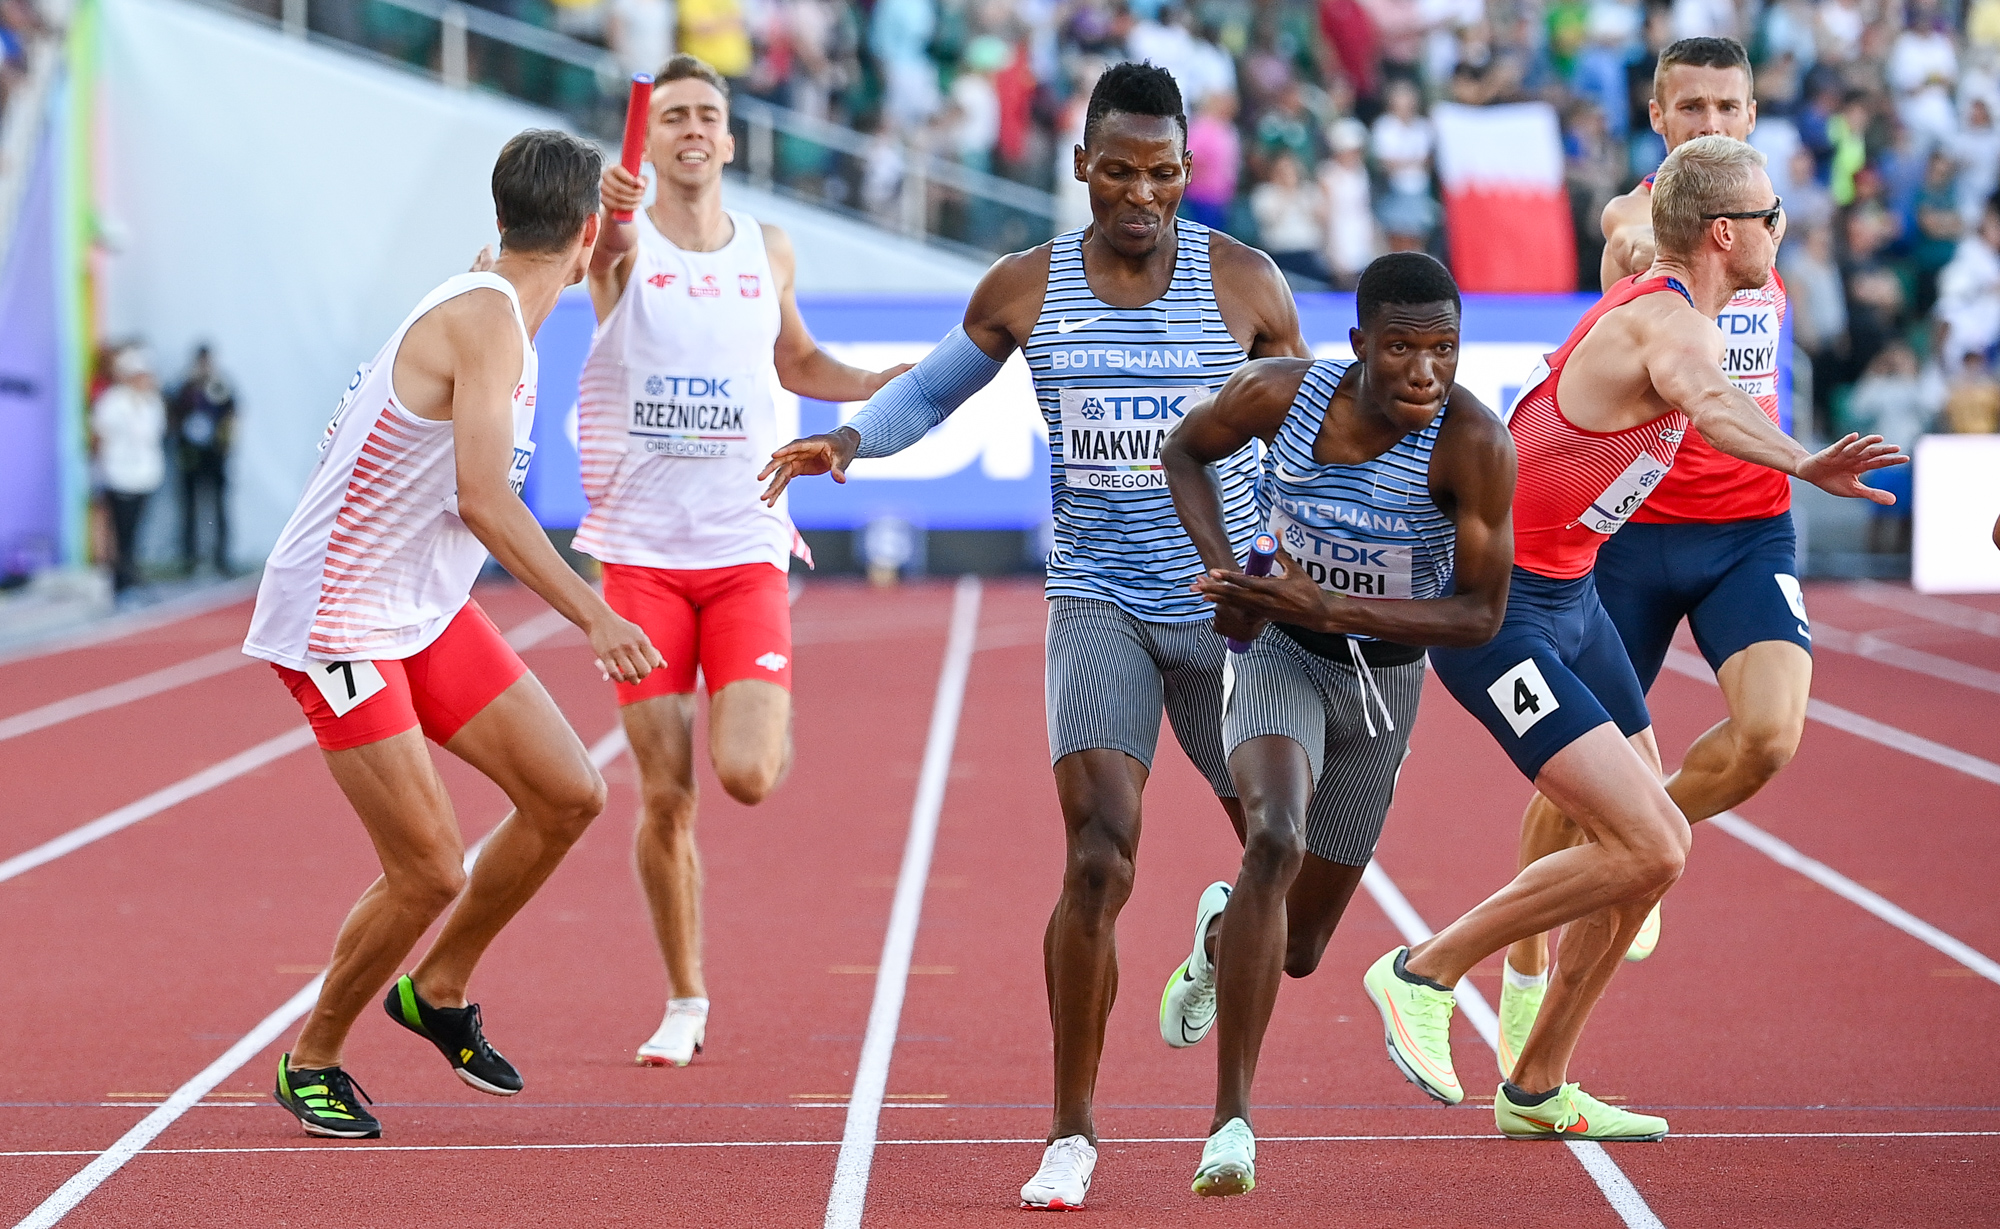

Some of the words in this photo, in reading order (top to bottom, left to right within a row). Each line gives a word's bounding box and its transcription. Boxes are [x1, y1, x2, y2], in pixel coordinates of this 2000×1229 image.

[1731, 288, 1775, 302] PUBLIC
[1052, 350, 1200, 370] BOTSWANA
[665, 376, 731, 398] TDK
[633, 400, 745, 431] RZEŹNICZAK
[1104, 395, 1188, 420] TDK
[1071, 429, 1166, 460] MAKWA
[1306, 532, 1389, 568] TDK
[1286, 550, 1385, 596] DORI
[325, 660, 357, 701] 7
[1514, 676, 1541, 716] 4
